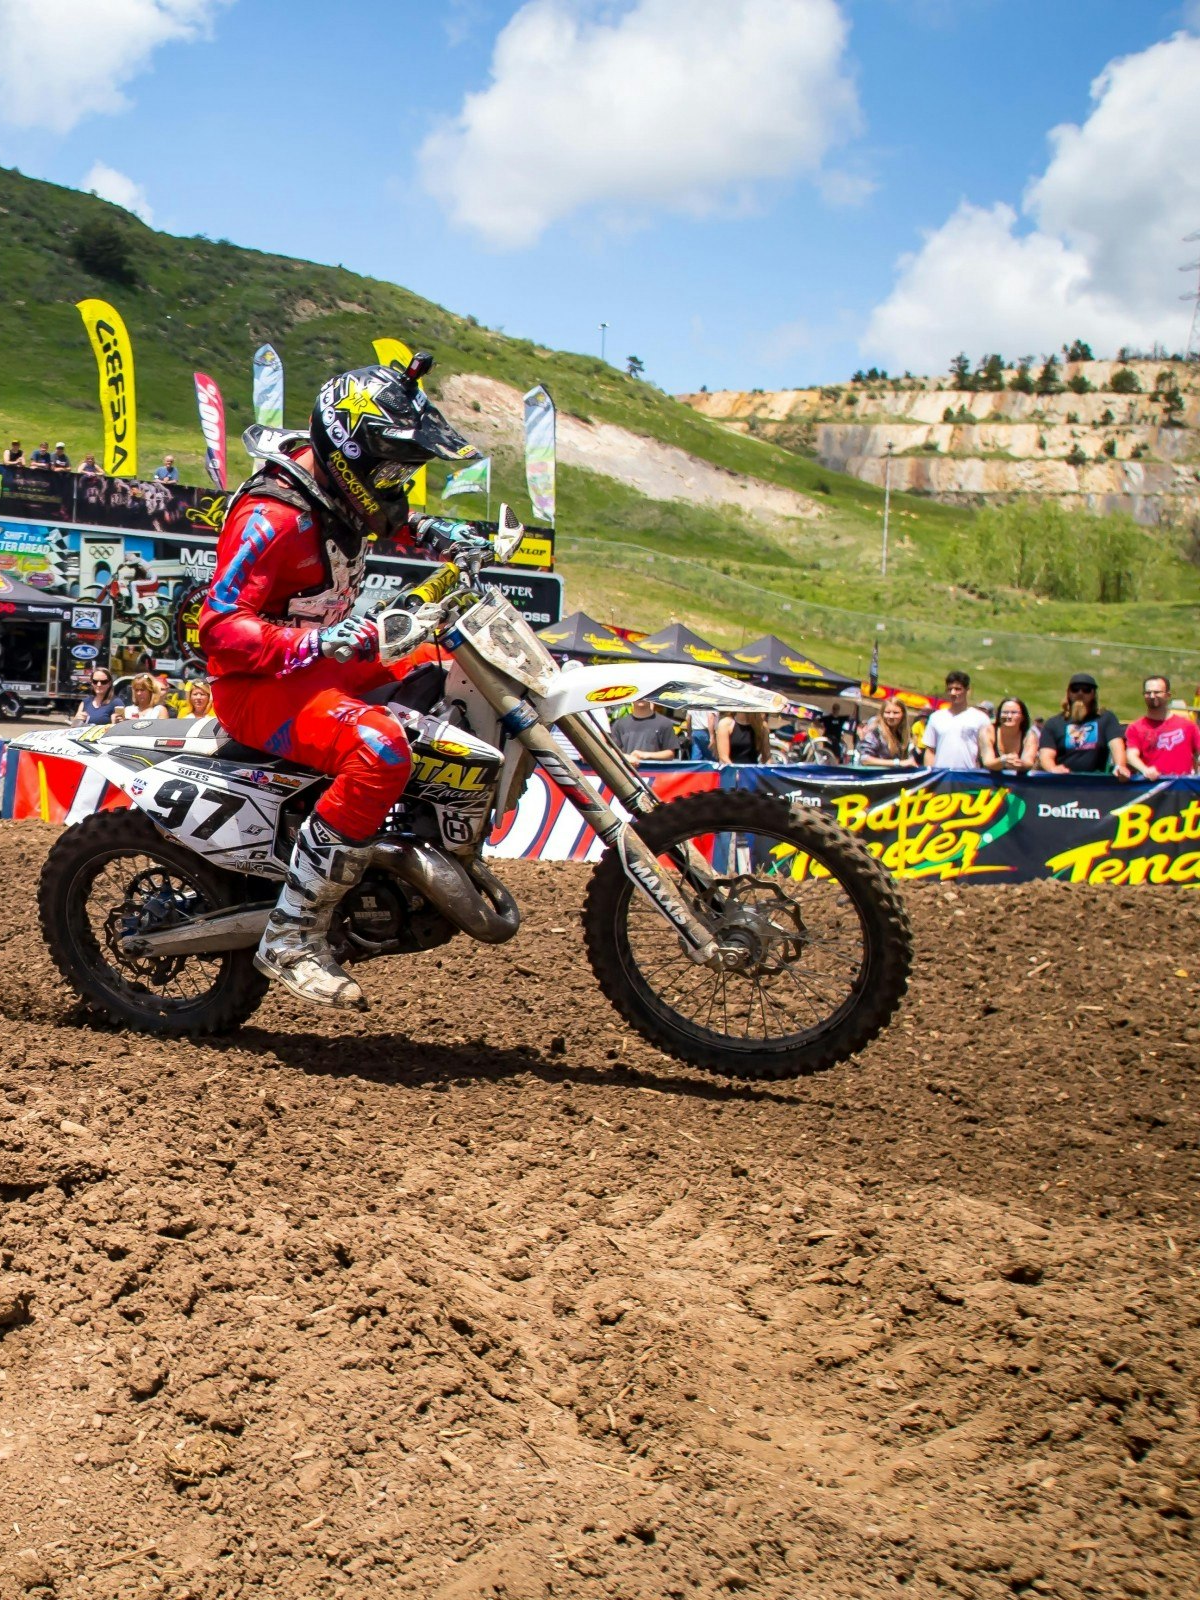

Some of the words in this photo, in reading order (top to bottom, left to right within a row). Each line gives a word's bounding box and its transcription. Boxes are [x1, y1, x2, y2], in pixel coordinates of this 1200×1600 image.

[3, 530, 28, 542] SHIFT
[18, 542, 50, 555] BREAD
[522, 611, 551, 623] OSS
[588, 685, 638, 702] FMF
[176, 766, 211, 783] SIPES
[147, 778, 248, 842] 97
[831, 787, 1011, 833] Battery
[1037, 800, 1100, 820] DelTran
[628, 860, 689, 926] MAXXIS
